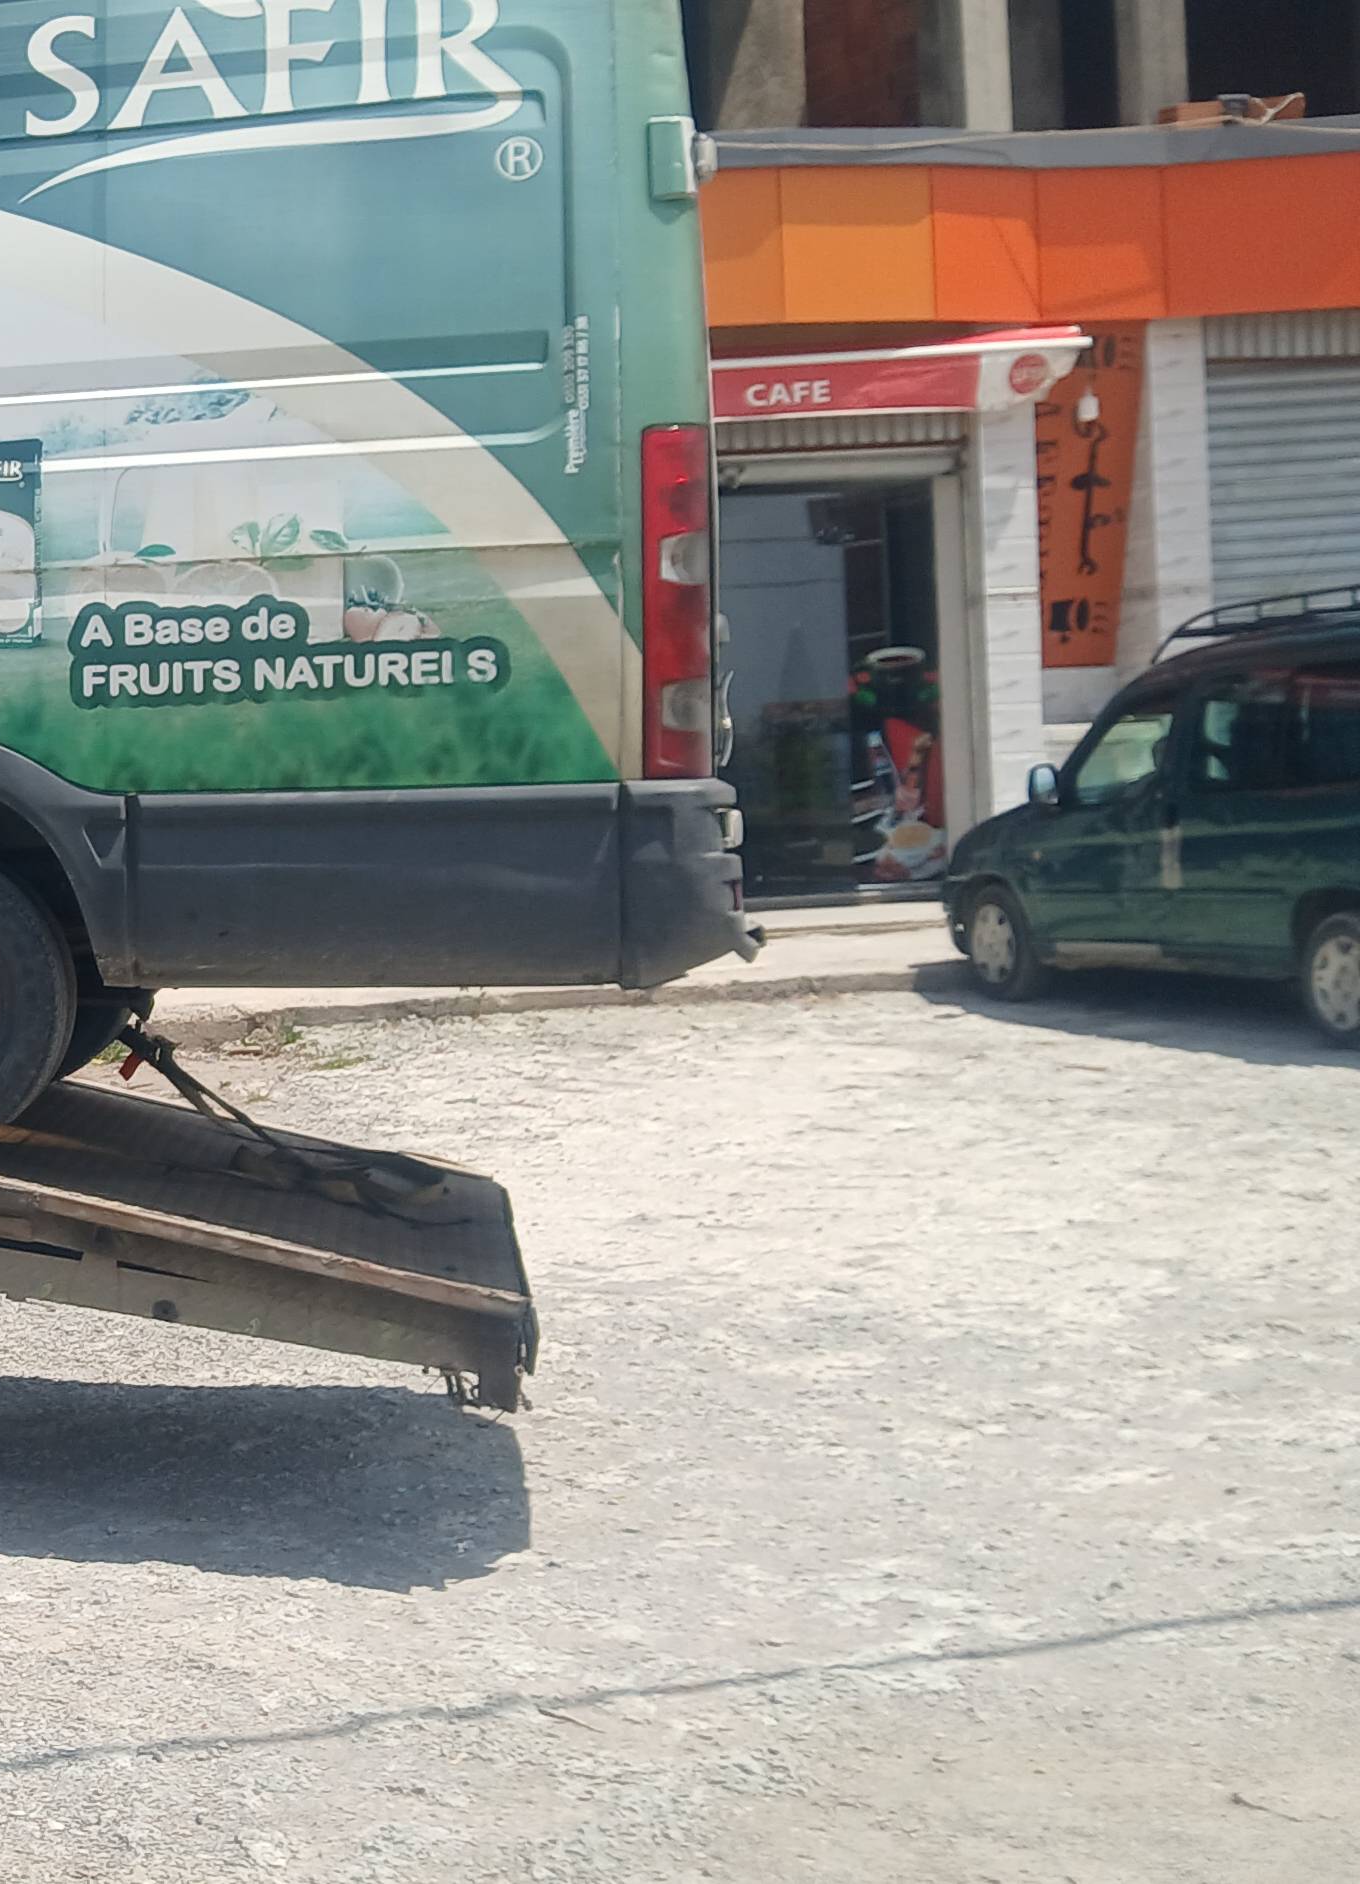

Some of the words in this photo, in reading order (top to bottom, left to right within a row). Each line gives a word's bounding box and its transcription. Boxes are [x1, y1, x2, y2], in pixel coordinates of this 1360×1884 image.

[26, 0, 524, 137] SAFIR
[744, 379, 832, 408] CAFE
[80, 613, 114, 649] A
[124, 612, 231, 647] Base
[241, 606, 297, 642] de
[82, 659, 242, 698] FRUITS
